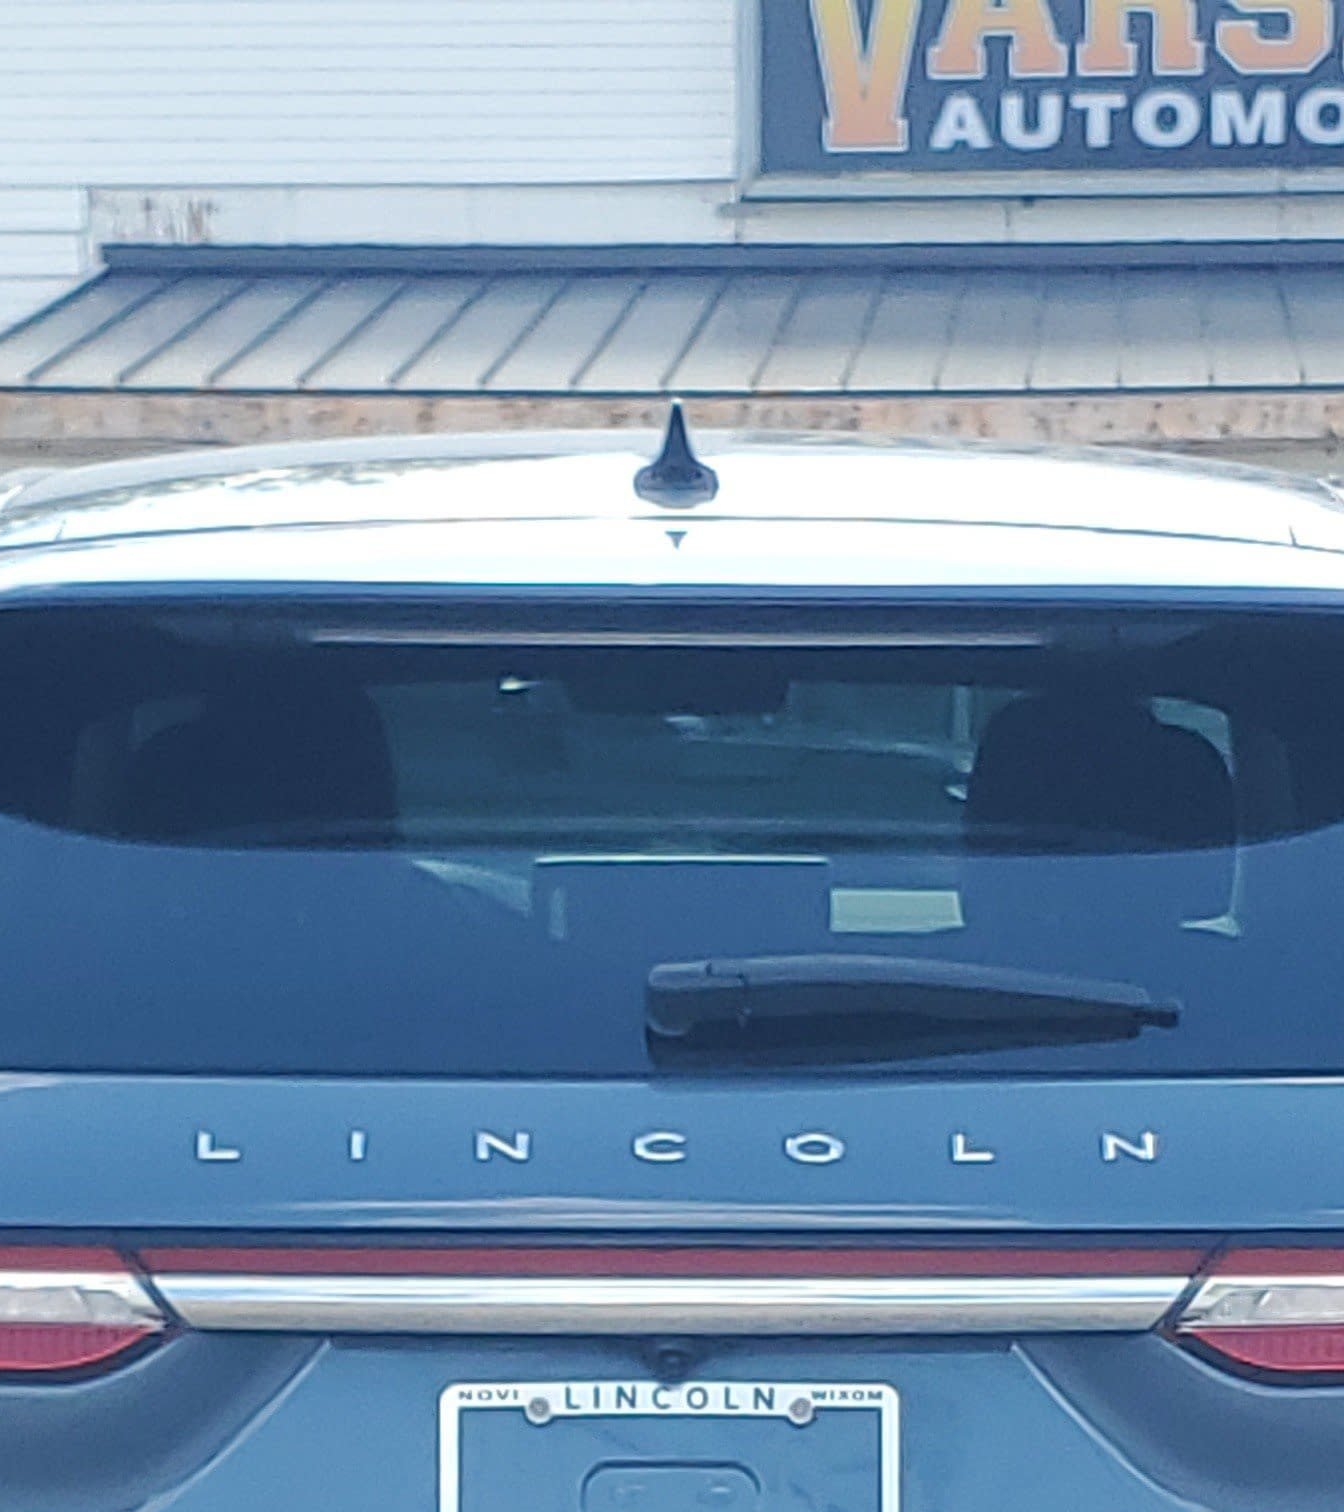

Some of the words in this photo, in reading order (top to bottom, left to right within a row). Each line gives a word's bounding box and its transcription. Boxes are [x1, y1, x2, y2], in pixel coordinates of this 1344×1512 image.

[196, 1131, 1156, 1163] LINCOLN
[457, 1389, 520, 1401] NOVI
[564, 1386, 776, 1410] LINCOLN
[811, 1389, 884, 1401] WIXOM
